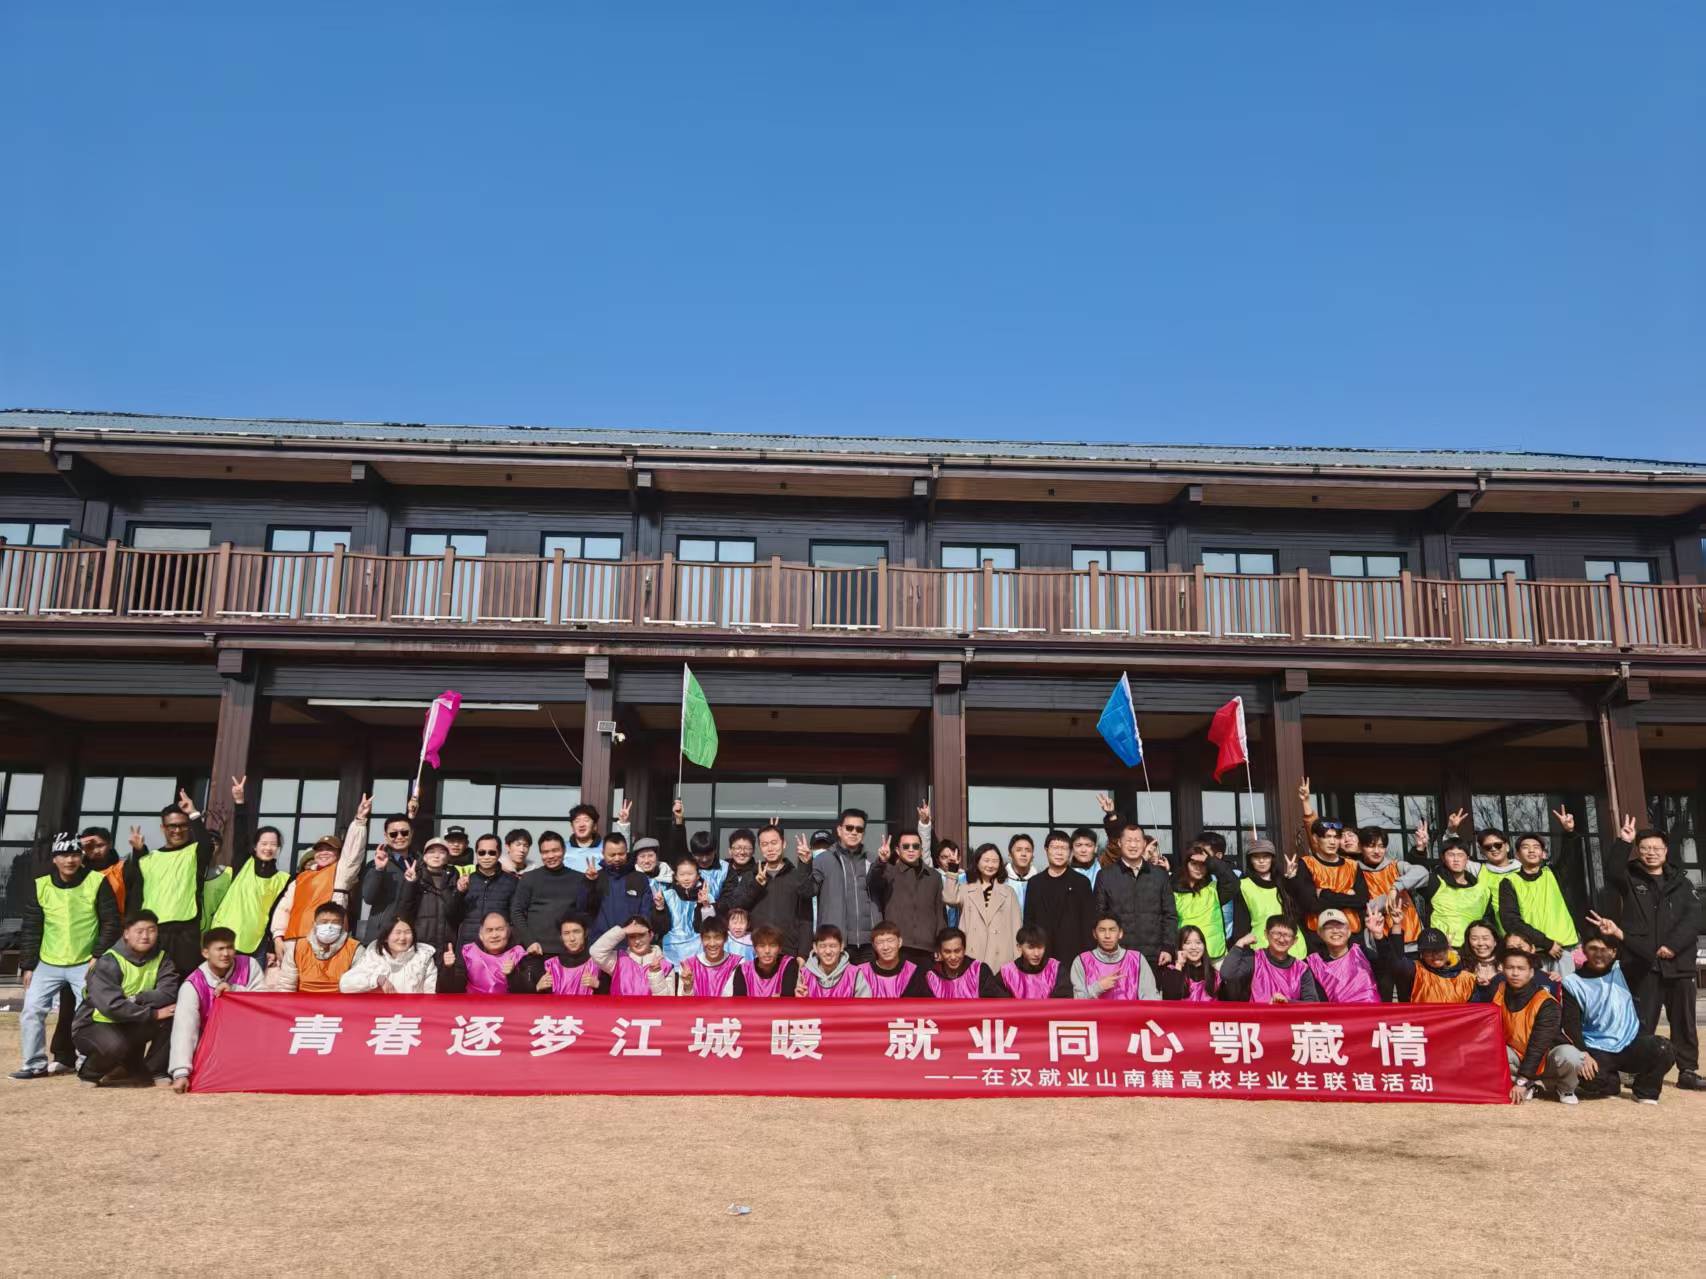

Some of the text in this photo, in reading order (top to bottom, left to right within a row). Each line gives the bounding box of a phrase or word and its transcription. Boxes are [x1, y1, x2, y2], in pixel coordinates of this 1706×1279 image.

[288, 1014, 1428, 1067] 青春逐梦江城暖 就业同心鄂藏情
